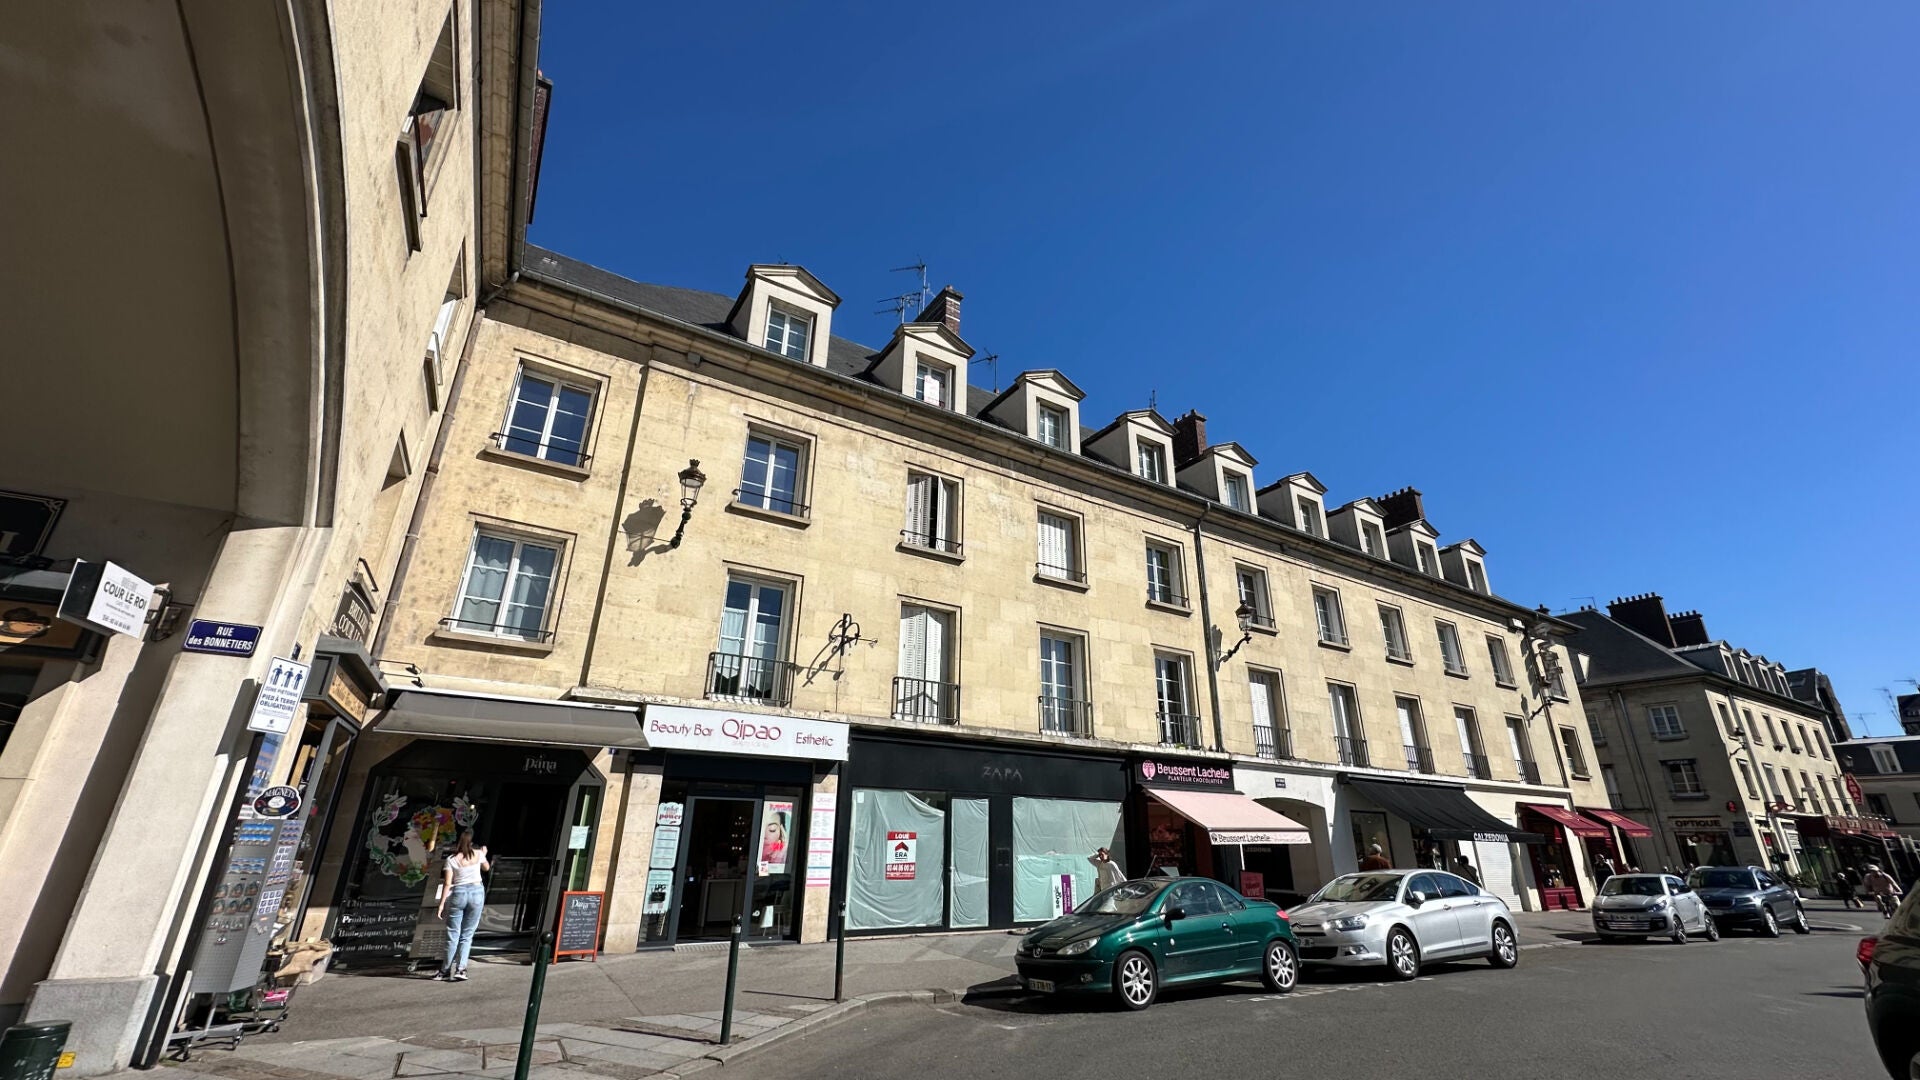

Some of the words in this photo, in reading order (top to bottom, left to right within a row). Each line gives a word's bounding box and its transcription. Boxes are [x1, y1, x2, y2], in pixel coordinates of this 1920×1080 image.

[103, 581, 126, 600] COUR
[124, 591, 135, 605] LE
[133, 596, 148, 612] ROI
[216, 626, 235, 637] RUE
[187, 635, 203, 646] des
[203, 636, 253, 651] BONNETIERS
[262, 693, 275, 702] PIED
[259, 700, 294, 712] OBLIGATOIRE
[650, 720, 692, 736] Beauty
[693, 723, 714, 737] Bar
[721, 718, 782, 741] Qipao
[795, 732, 834, 747] Esthetic
[1157, 763, 1197, 777] Beussent
[1197, 766, 1230, 779] Lachelle
[1217, 833, 1245, 843] Beussent
[1473, 832, 1510, 842] CALZEDONIA
